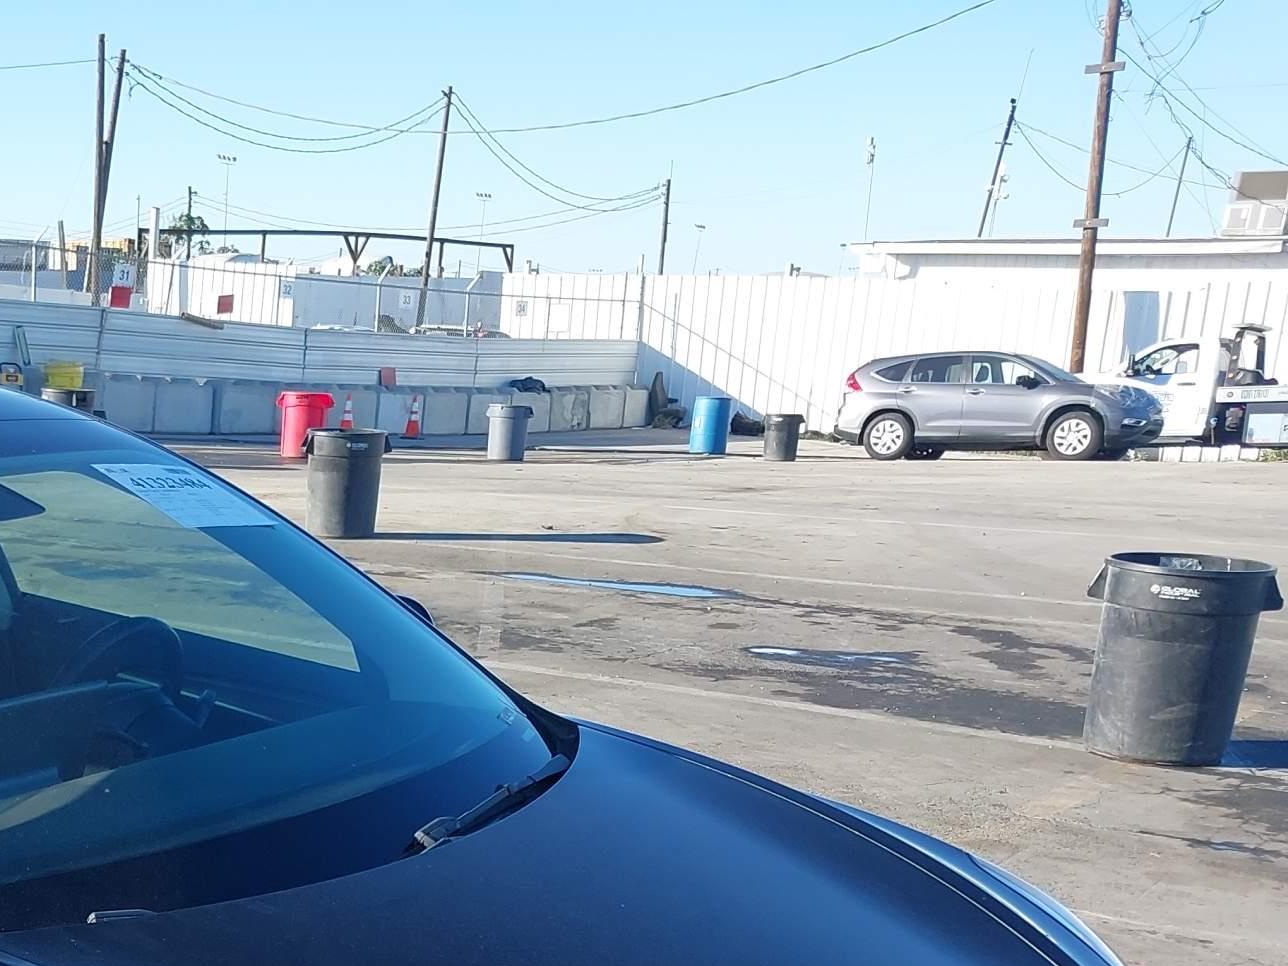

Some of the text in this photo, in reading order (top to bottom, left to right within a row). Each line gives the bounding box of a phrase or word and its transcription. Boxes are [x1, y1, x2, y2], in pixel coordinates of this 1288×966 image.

[119, 270, 130, 281] 31
[282, 284, 292, 295] 32
[402, 295, 411, 305] 33
[129, 477, 213, 490] 41323484
[1160, 585, 1201, 595] GLOBAL
